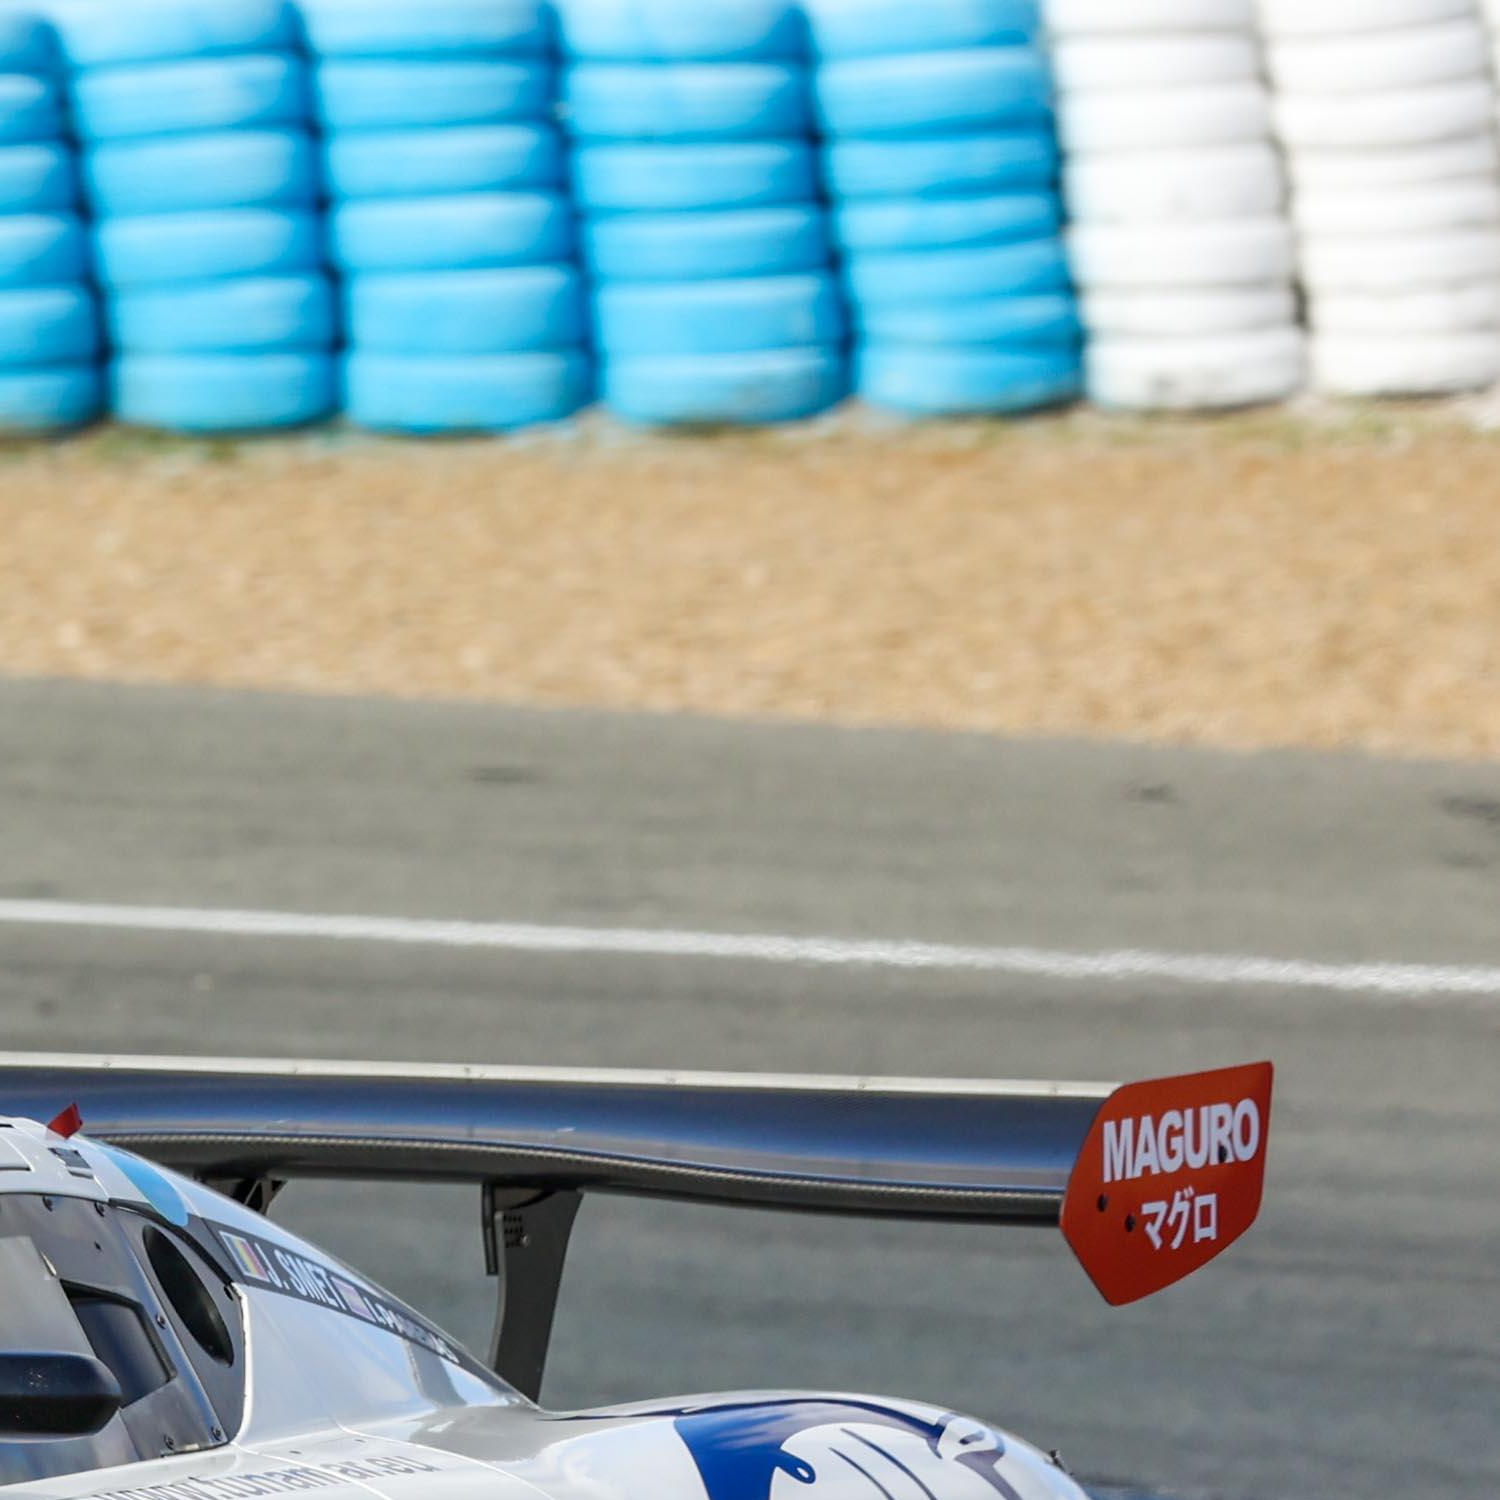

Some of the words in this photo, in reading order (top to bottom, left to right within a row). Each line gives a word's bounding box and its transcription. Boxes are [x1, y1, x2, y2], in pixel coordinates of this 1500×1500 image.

[1103, 1098, 1260, 1183] MAGURO
[1141, 1186, 1217, 1250] マグロ
